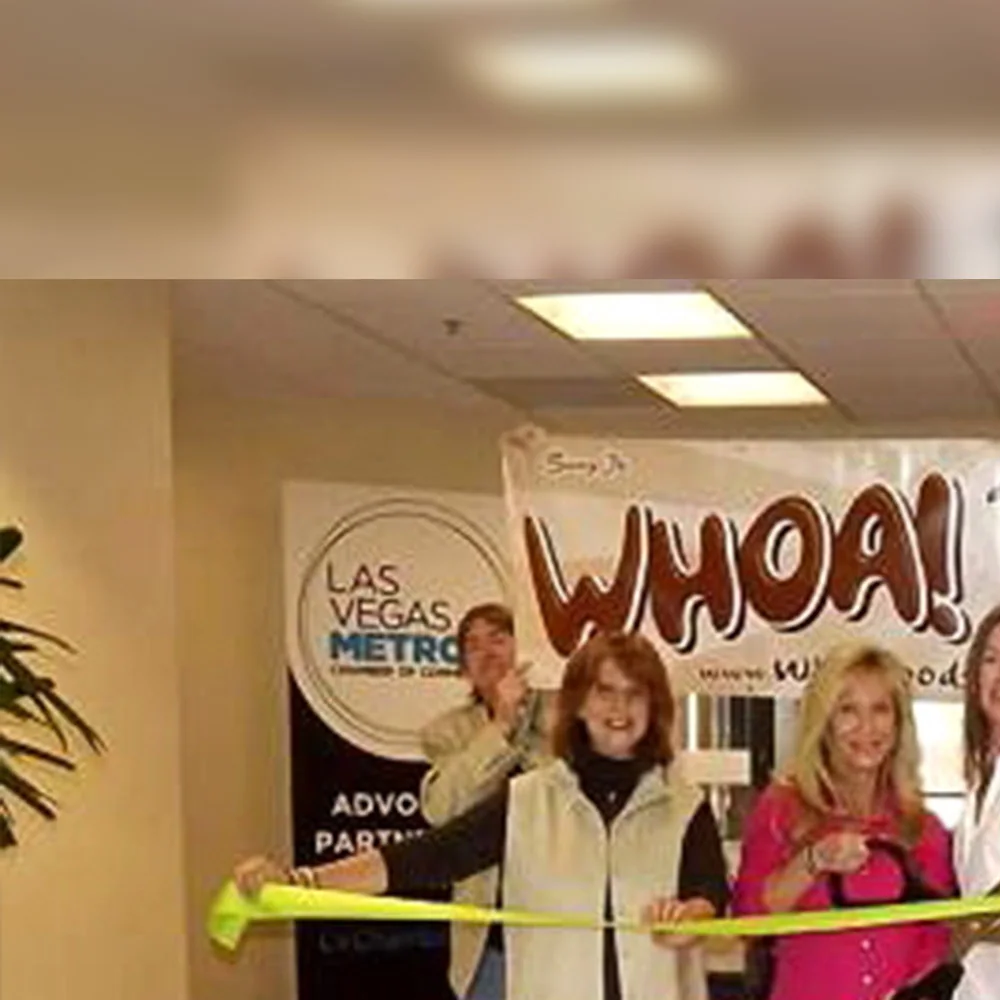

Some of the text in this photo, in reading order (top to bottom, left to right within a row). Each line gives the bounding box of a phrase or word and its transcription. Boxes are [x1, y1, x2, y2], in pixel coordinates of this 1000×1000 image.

[327, 562, 400, 596] LAS
[523, 472, 971, 657] WHOA!
[329, 597, 453, 633] VEGAS
[330, 791, 419, 818] ADVO
